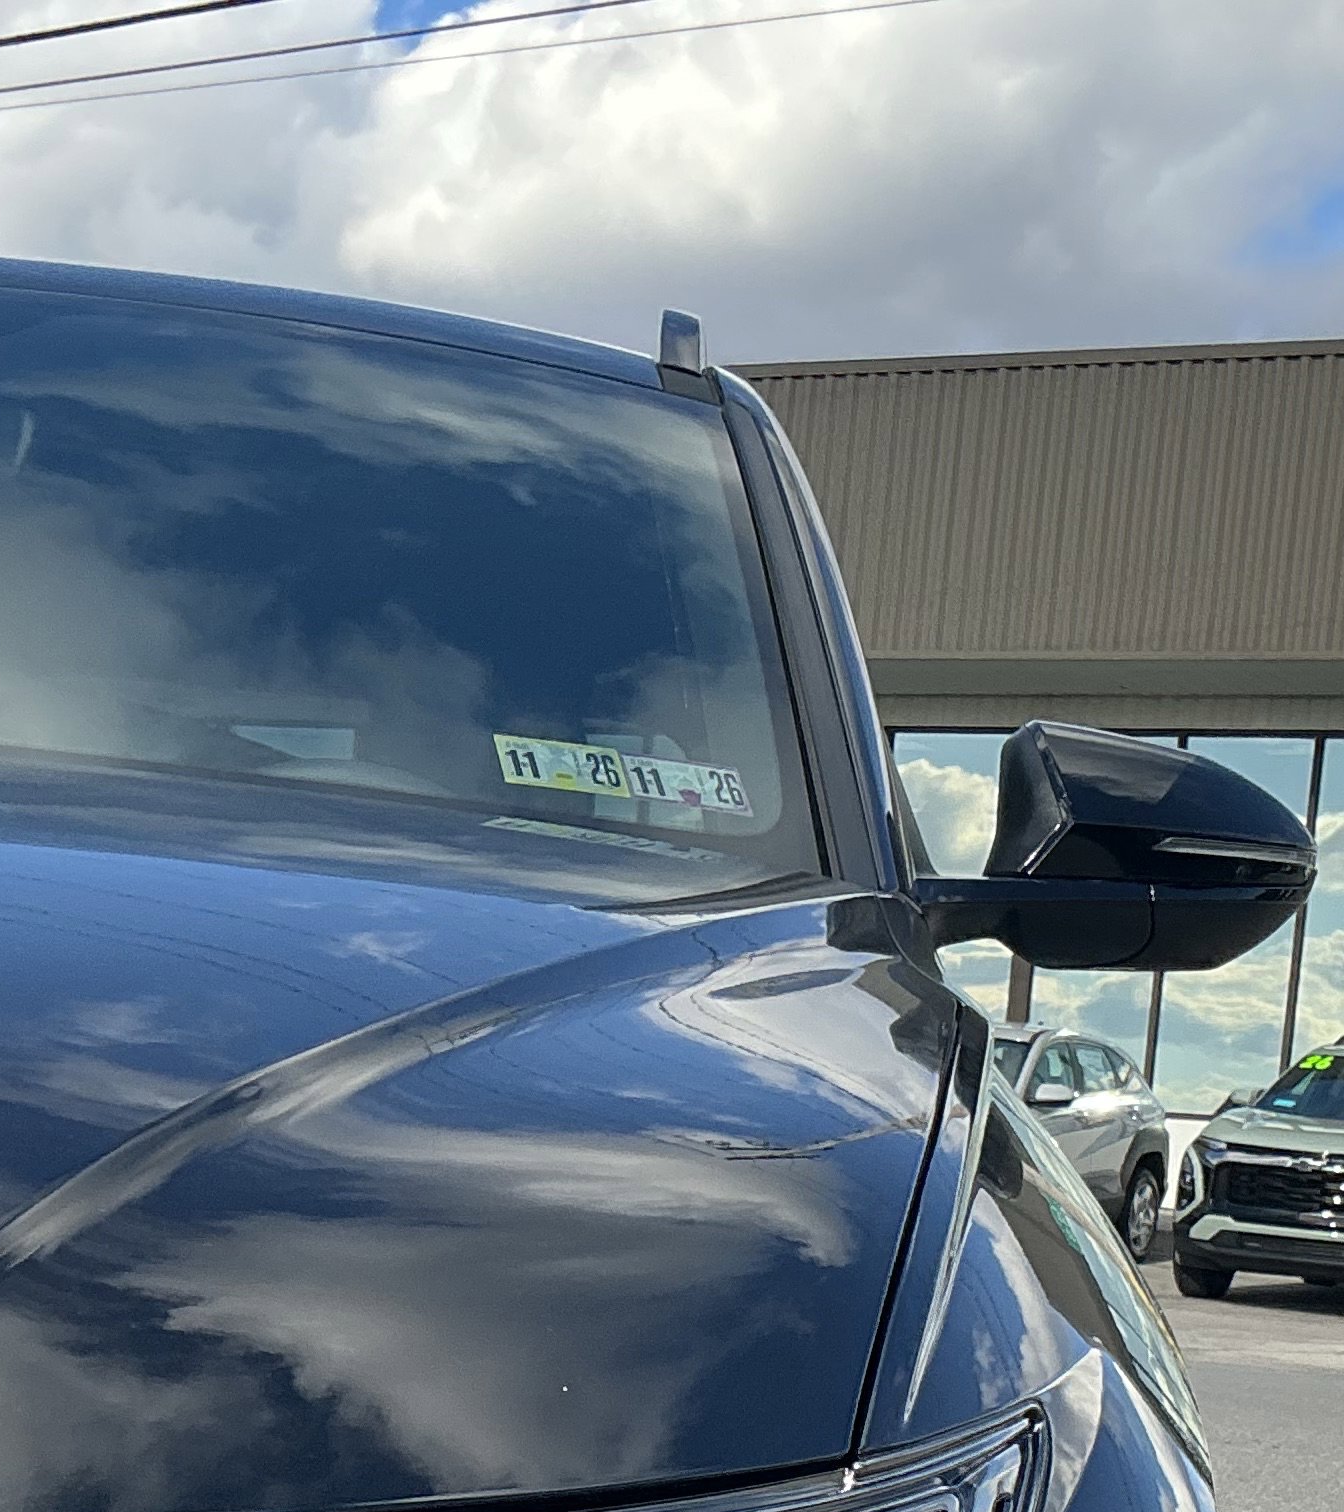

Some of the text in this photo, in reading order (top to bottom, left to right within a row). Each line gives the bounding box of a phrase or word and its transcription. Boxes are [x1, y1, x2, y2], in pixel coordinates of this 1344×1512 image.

[504, 749, 622, 788] 11 26
[629, 766, 745, 806] 11 26
[1297, 1055, 1335, 1070] 26
